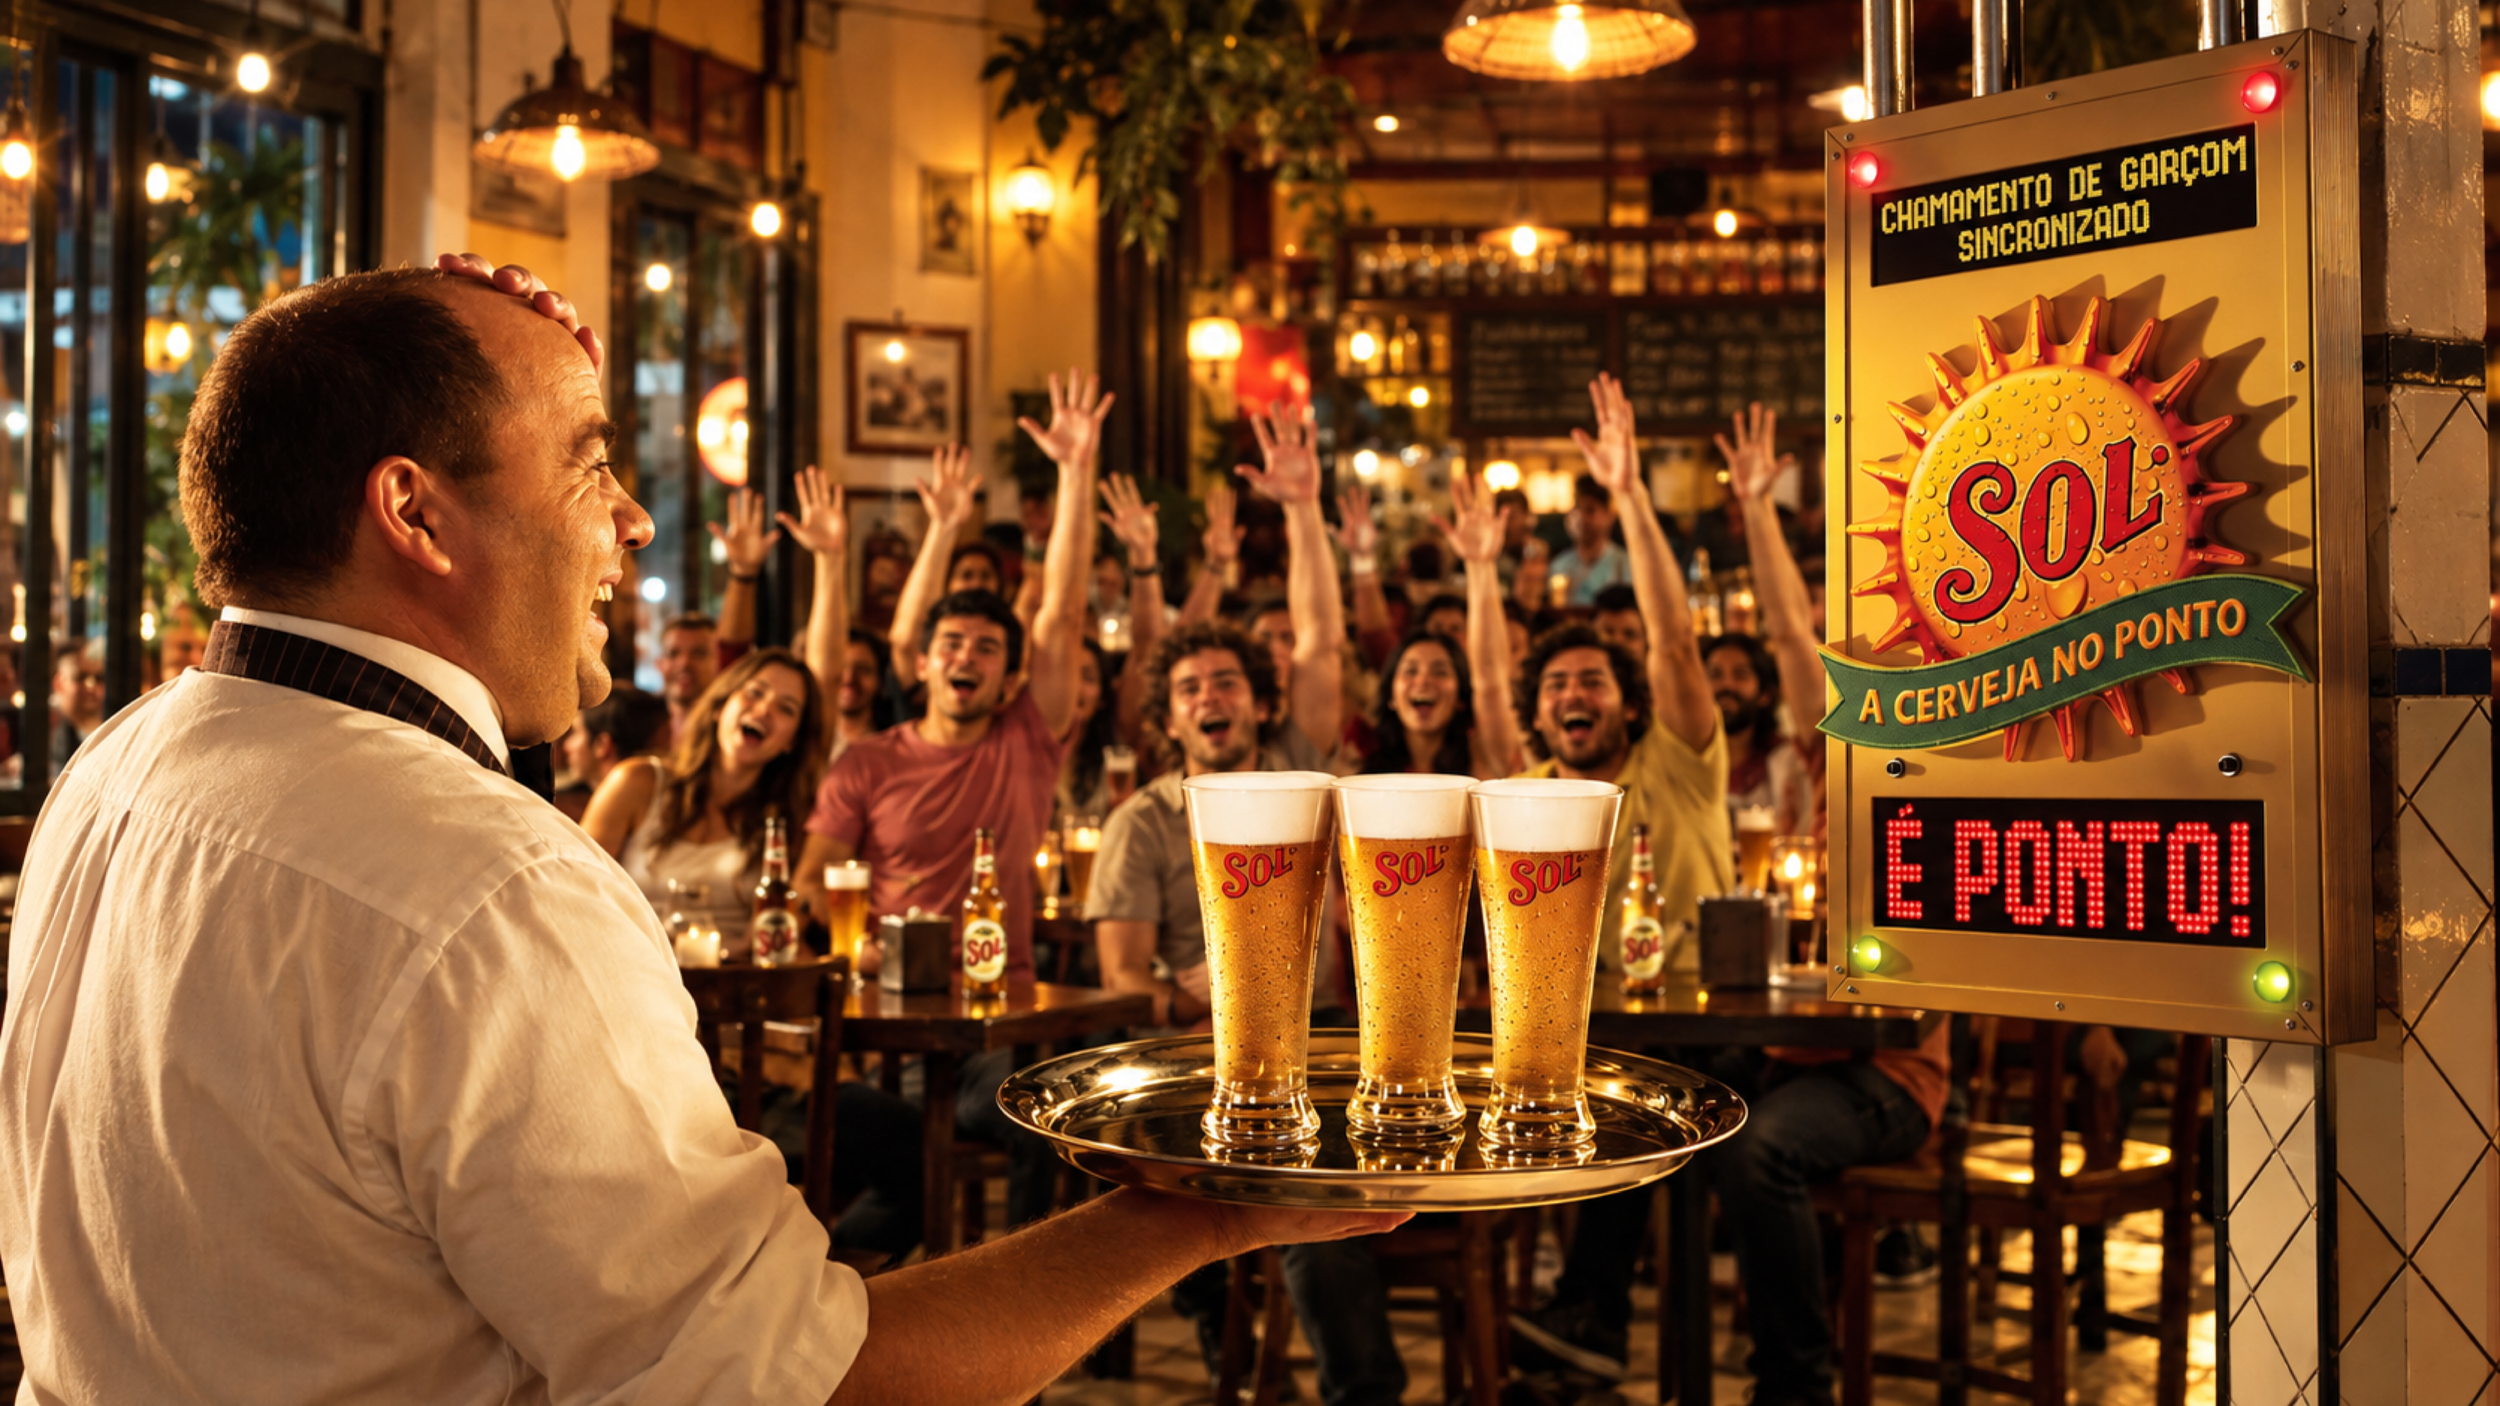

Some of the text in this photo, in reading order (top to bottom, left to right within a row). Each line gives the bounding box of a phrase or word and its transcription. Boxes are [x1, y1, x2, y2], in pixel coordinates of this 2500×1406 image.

[1881, 136, 2247, 234] CHAMAMENTO DE GARÇOM
[1958, 200, 2150, 262] SINCRONIZADO
[1934, 436, 2168, 624] SOL
[1859, 598, 2246, 725] A CERVEJA NO PONTO
[1222, 847, 1295, 899] SOL
[1373, 845, 1446, 898] SOL
[1508, 854, 1584, 907] SOL
[1887, 804, 2250, 937] É PONTO!
[967, 936, 1003, 967] SOL
[1625, 935, 1661, 965] SOL
